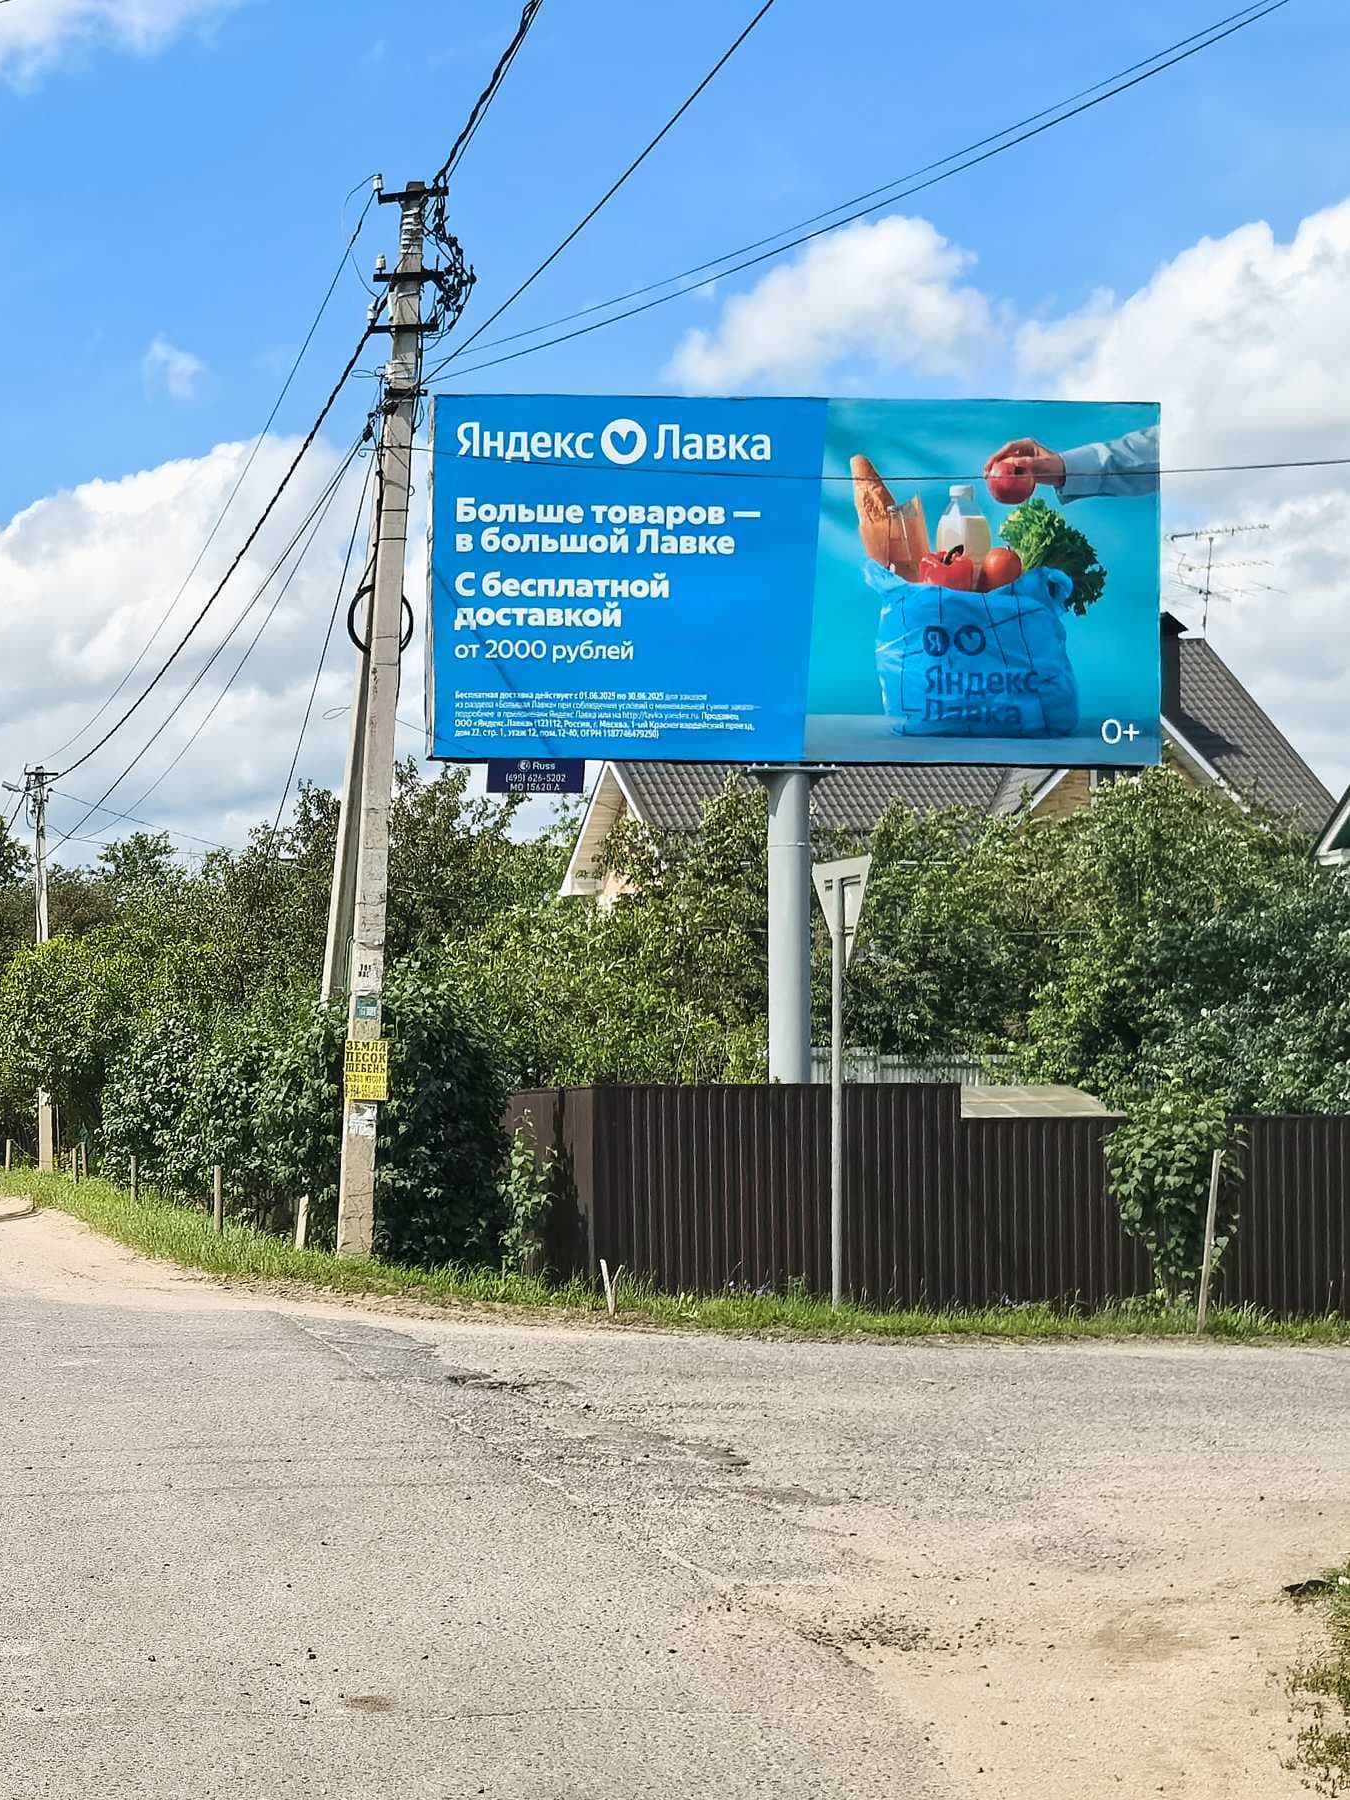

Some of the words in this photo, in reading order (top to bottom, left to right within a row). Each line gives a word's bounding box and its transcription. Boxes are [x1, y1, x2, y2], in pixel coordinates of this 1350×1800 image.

[456, 421, 594, 463] Яндекс
[653, 424, 771, 461] Лавка
[455, 497, 584, 524] Больше
[591, 504, 726, 530] товаров
[455, 533, 473, 553] в
[480, 526, 629, 554] большой
[636, 529, 735, 555] Лавке
[454, 571, 475, 597] С
[481, 571, 670, 599] бесплатной
[454, 602, 622, 631] доставкой
[454, 643, 480, 660] от
[484, 639, 547, 660] 2000
[551, 639, 634, 664] рублей
[924, 664, 1039, 699] Яндекс
[1101, 718, 1140, 745] 0+
[527, 773, 566, 783] 626-5202
[532, 761, 556, 770] Russ
[526, 783, 552, 792] 15620
[345, 1041, 386, 1052] ЗЕМЛЯ
[345, 1051, 386, 1063] ПЕСОК
